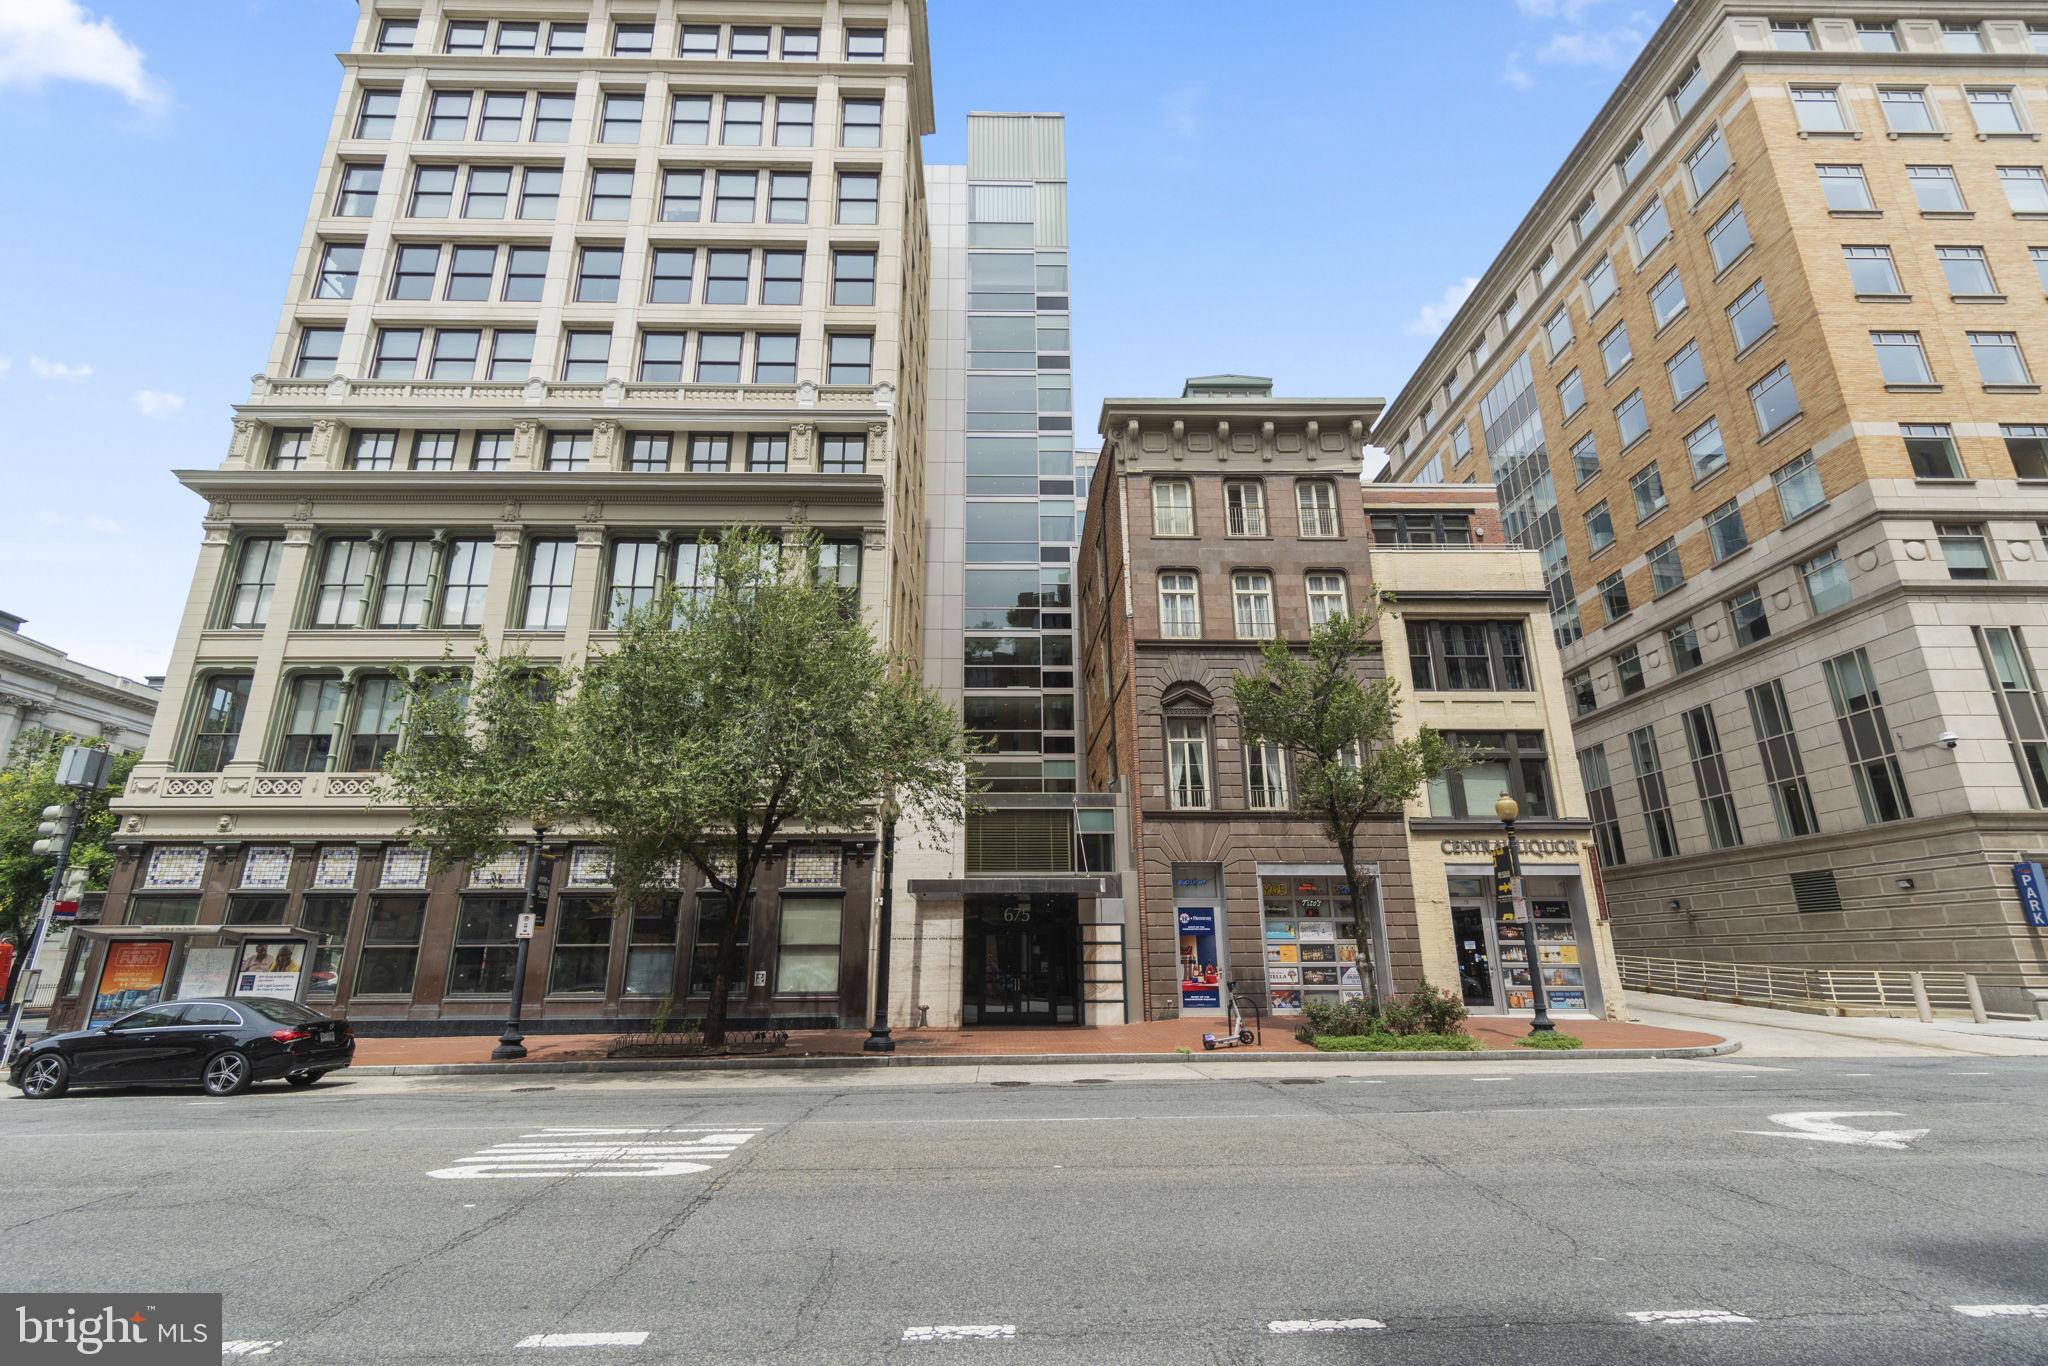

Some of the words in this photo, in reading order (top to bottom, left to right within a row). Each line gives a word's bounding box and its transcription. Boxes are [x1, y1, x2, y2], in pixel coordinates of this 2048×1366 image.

[1440, 839, 1507, 855] CENTRA
[1301, 899, 1322, 907] Tito's
[2021, 874, 2046, 924] PARK
[1004, 906, 1030, 922] 675
